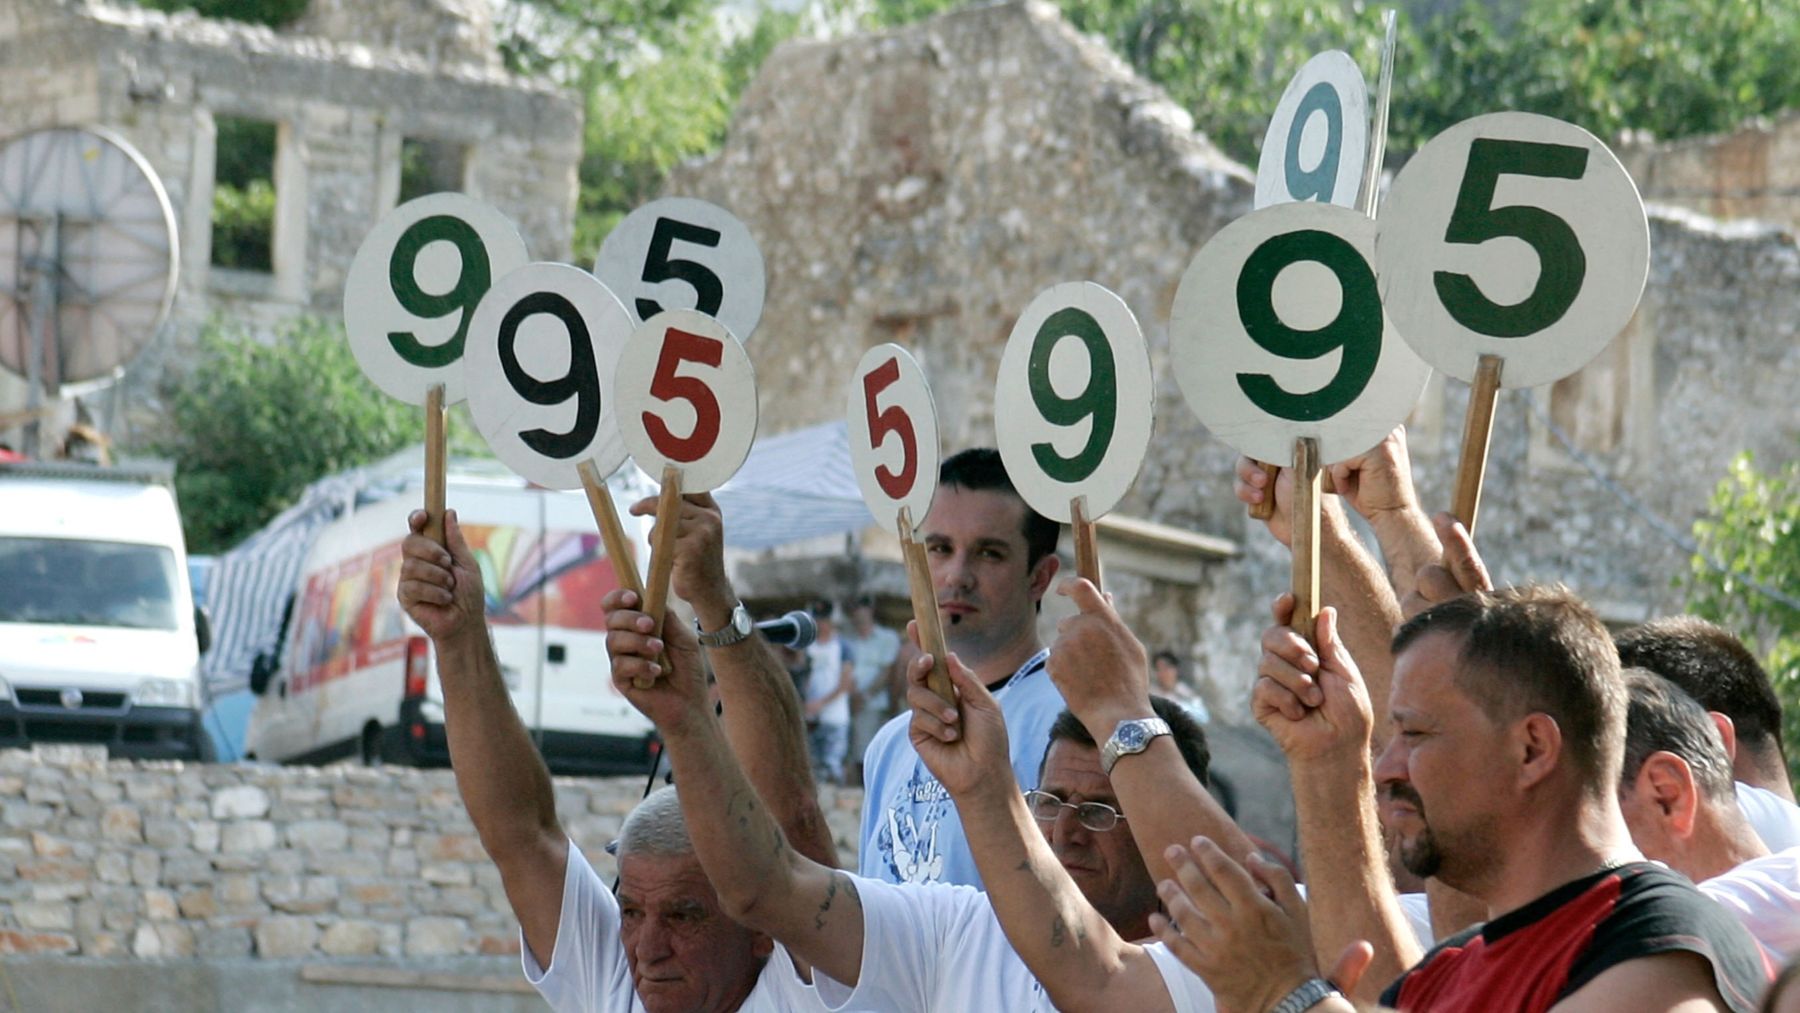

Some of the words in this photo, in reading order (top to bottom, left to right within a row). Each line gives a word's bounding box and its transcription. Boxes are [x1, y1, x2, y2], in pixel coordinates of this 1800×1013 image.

[1284, 81, 1343, 204] 9
[387, 214, 492, 368] 9
[635, 216, 724, 322] 5
[1433, 138, 1589, 338] 5
[497, 291, 601, 459] 9
[642, 327, 723, 463] 5
[1028, 307, 1117, 483] 9
[1236, 229, 1383, 422] 9
[863, 357, 918, 500] 5
